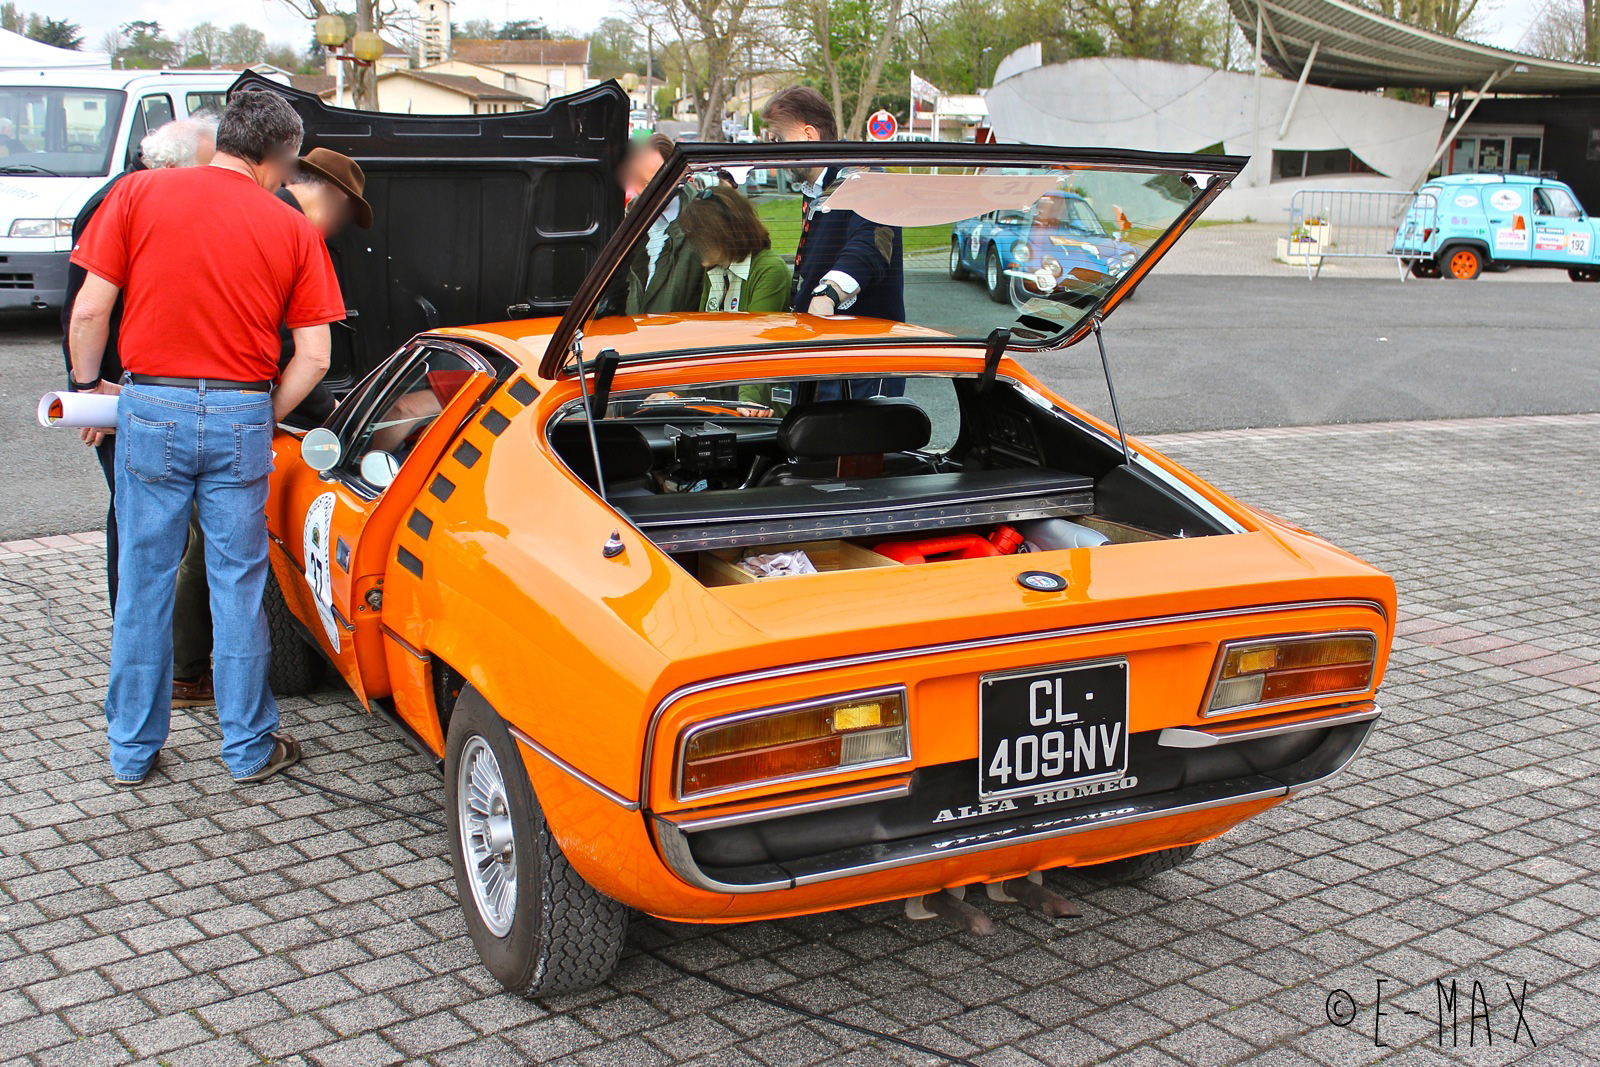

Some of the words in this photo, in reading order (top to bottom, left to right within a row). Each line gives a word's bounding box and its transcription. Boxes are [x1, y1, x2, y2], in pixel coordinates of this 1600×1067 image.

[1571, 239, 1585, 251] 192
[932, 798, 1019, 824] ALFA
[1033, 775, 1139, 806] ROMEO
